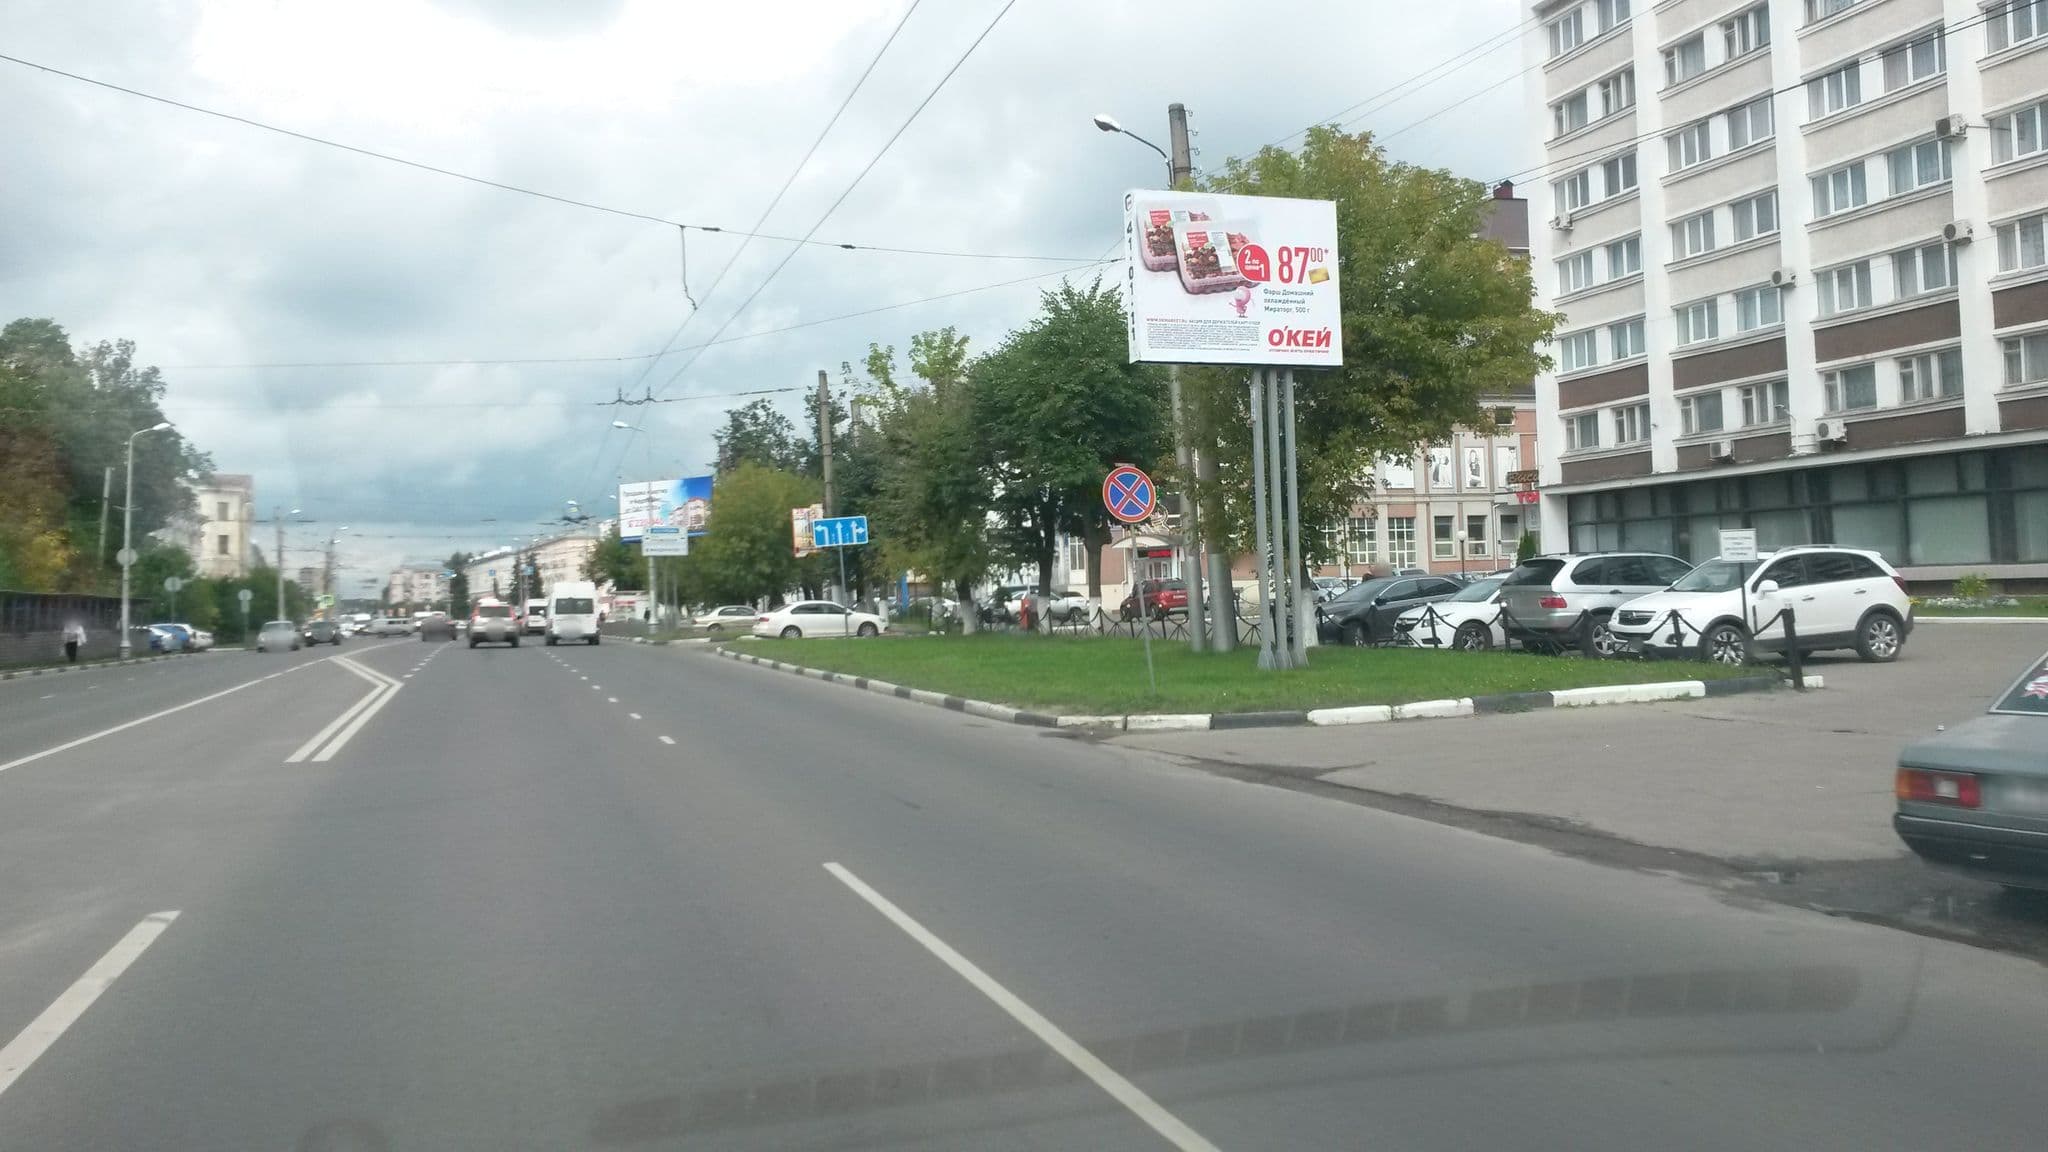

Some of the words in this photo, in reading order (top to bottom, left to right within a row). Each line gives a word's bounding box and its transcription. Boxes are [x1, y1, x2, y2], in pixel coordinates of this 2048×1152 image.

[1244, 249, 1251, 264] 2
[1259, 264, 1265, 278] 1
[1278, 246, 1310, 284] 87
[1282, 289, 1314, 297] Домашний
[1295, 306, 1306, 314] 500
